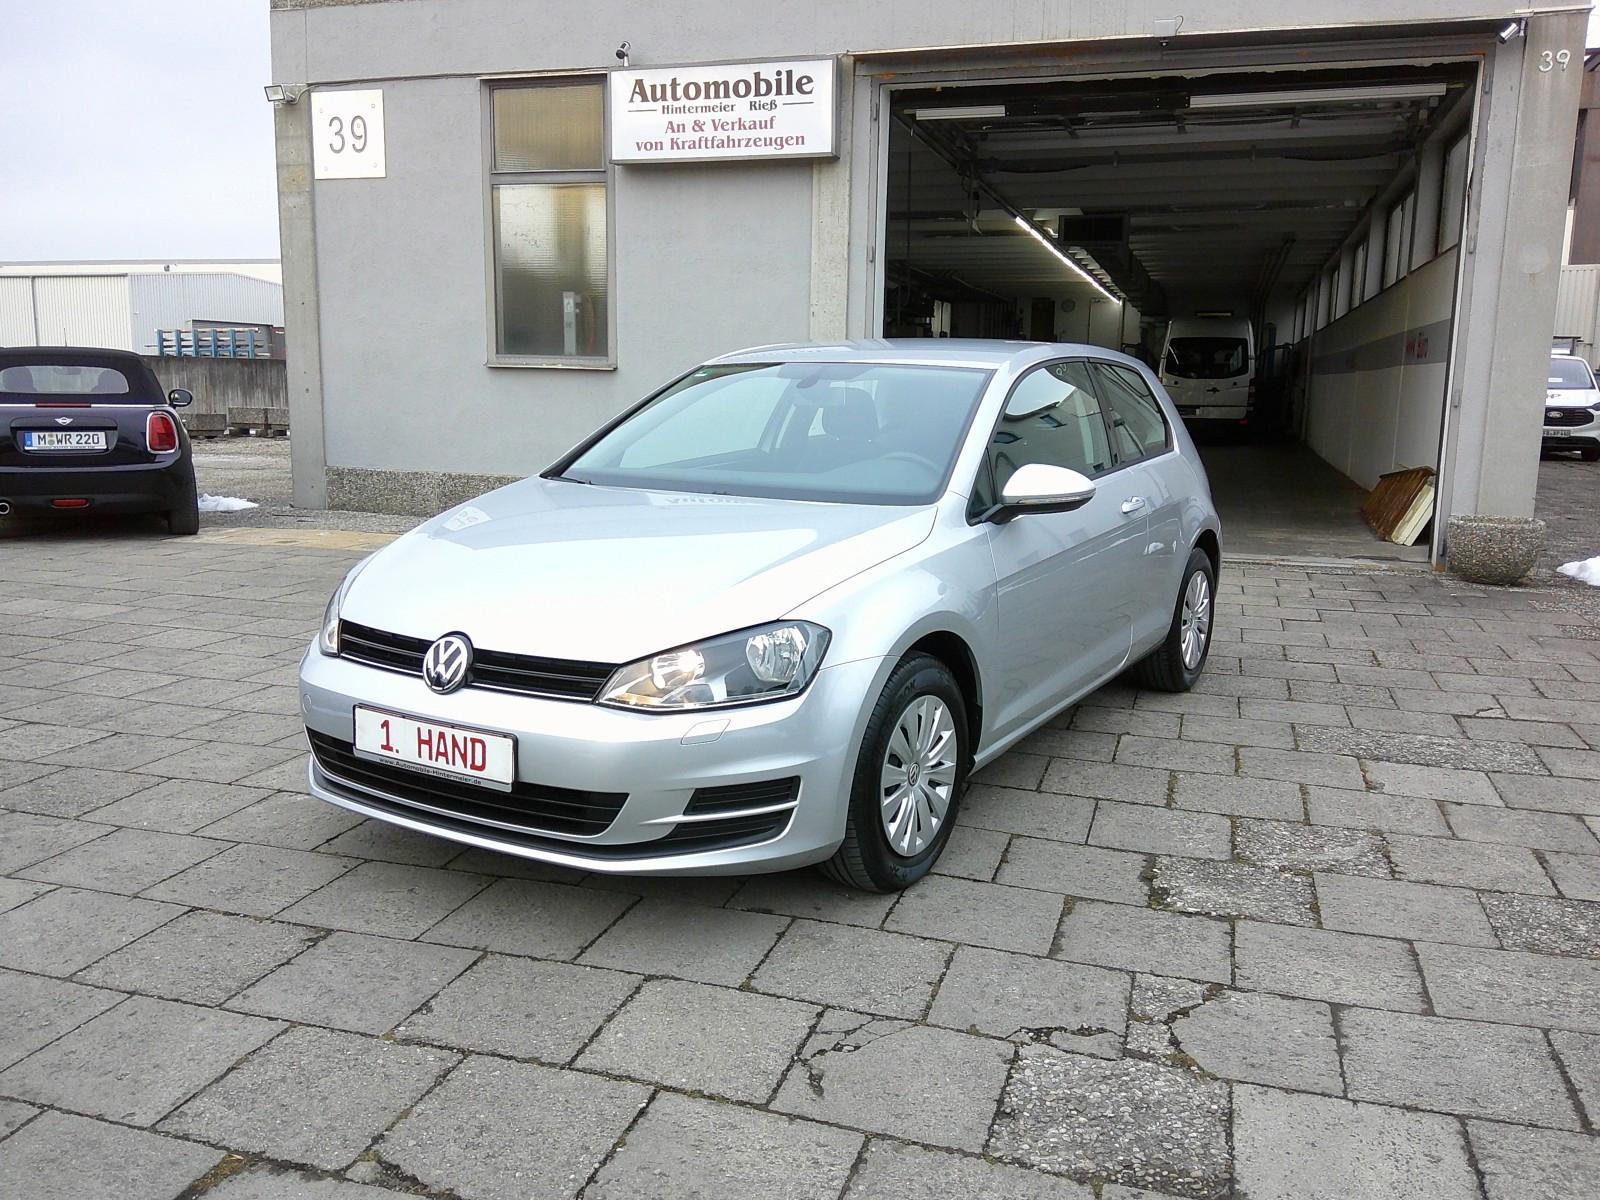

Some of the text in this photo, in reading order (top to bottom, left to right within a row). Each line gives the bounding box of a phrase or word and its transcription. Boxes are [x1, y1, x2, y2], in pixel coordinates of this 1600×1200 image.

[1538, 49, 1571, 72] 39
[628, 69, 815, 103] Automobile
[661, 99, 778, 115] Hintermeier Rieß
[328, 115, 368, 154] 39
[664, 116, 777, 134] An & Verkauf
[635, 134, 805, 151] von Kraftfahrzeugen
[37, 433, 100, 445] M WR 220
[380, 719, 487, 772] 1. HAND
